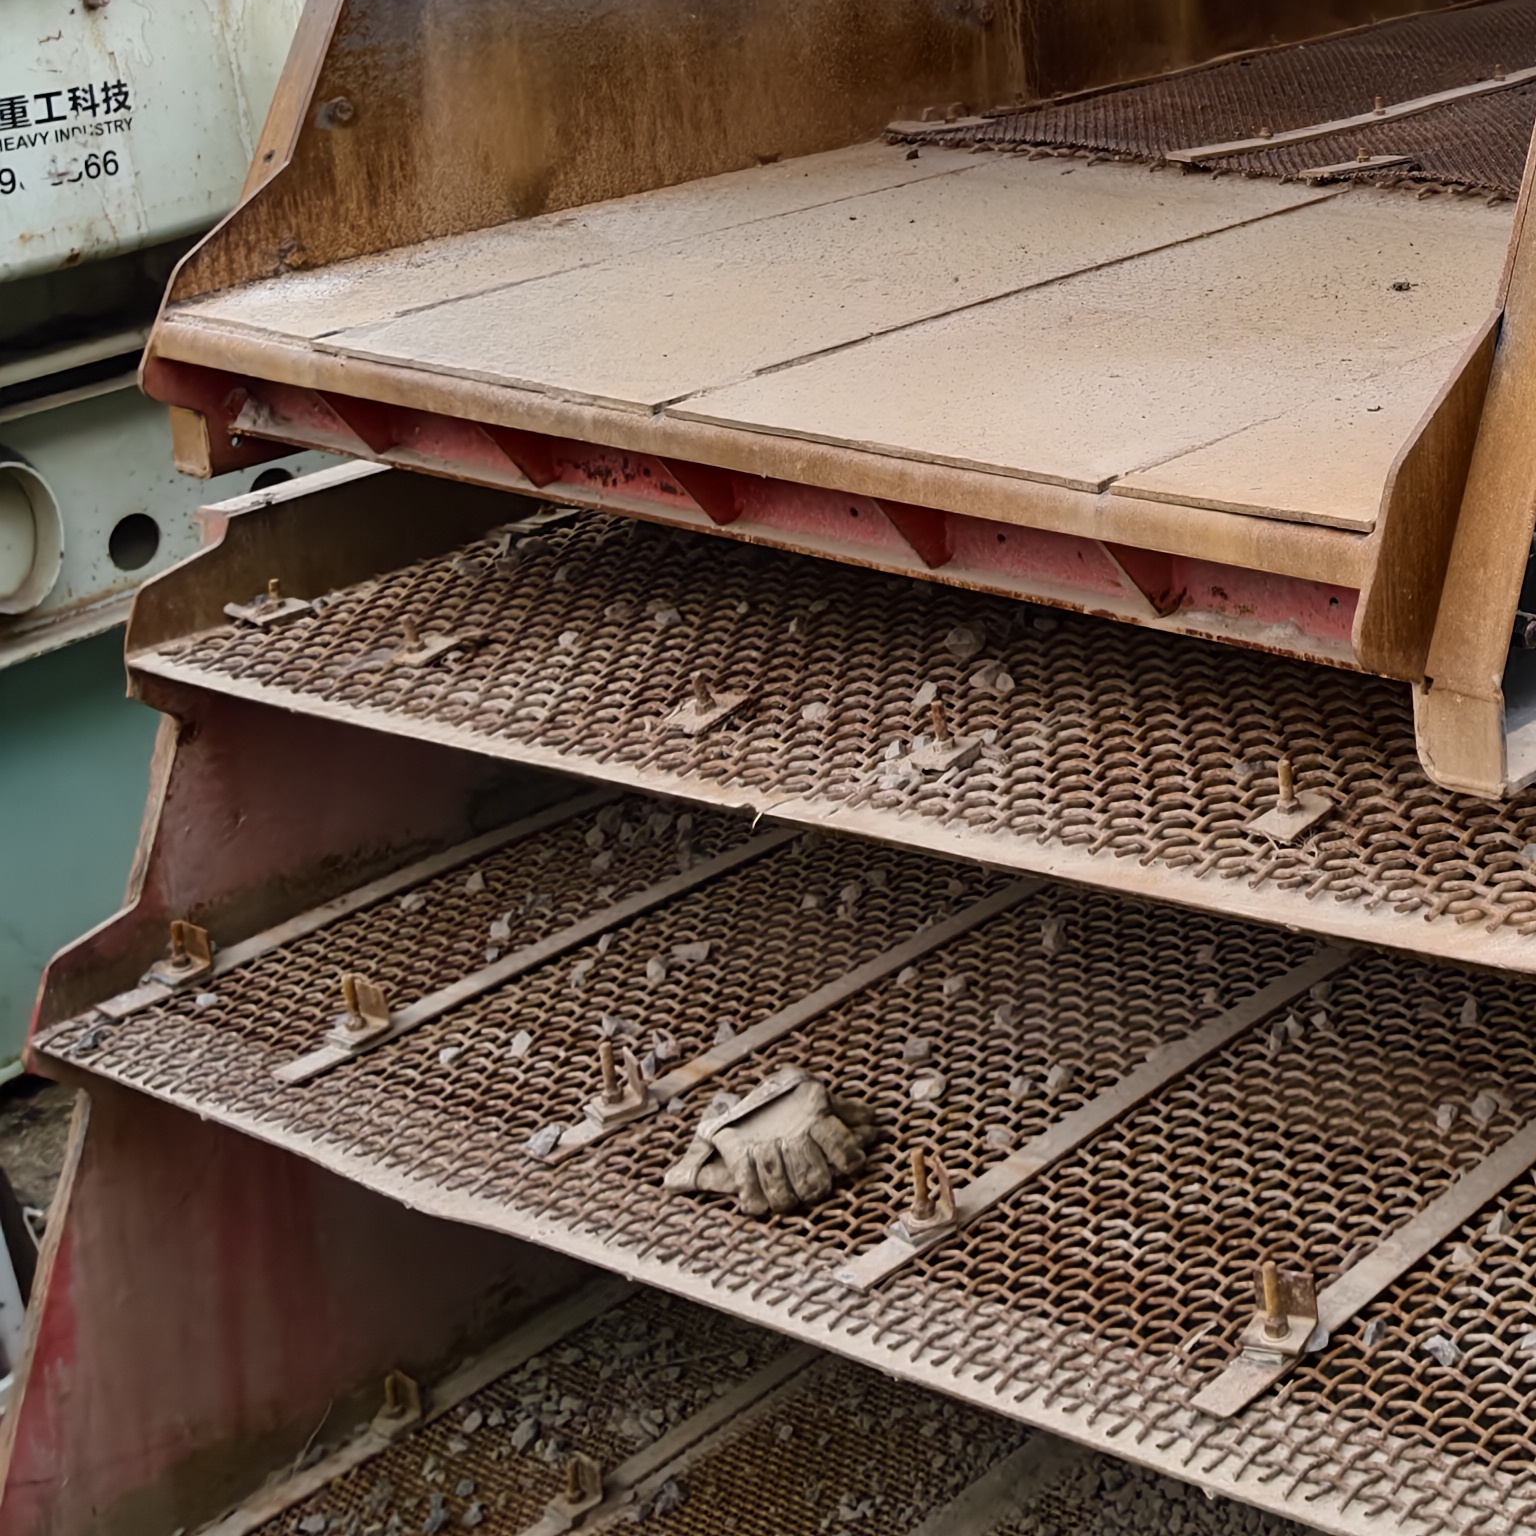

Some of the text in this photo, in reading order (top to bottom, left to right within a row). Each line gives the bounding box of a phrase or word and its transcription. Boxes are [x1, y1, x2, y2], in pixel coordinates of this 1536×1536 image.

[0, 79, 132, 131] 重工科技
[0, 131, 49, 152] EAVY
